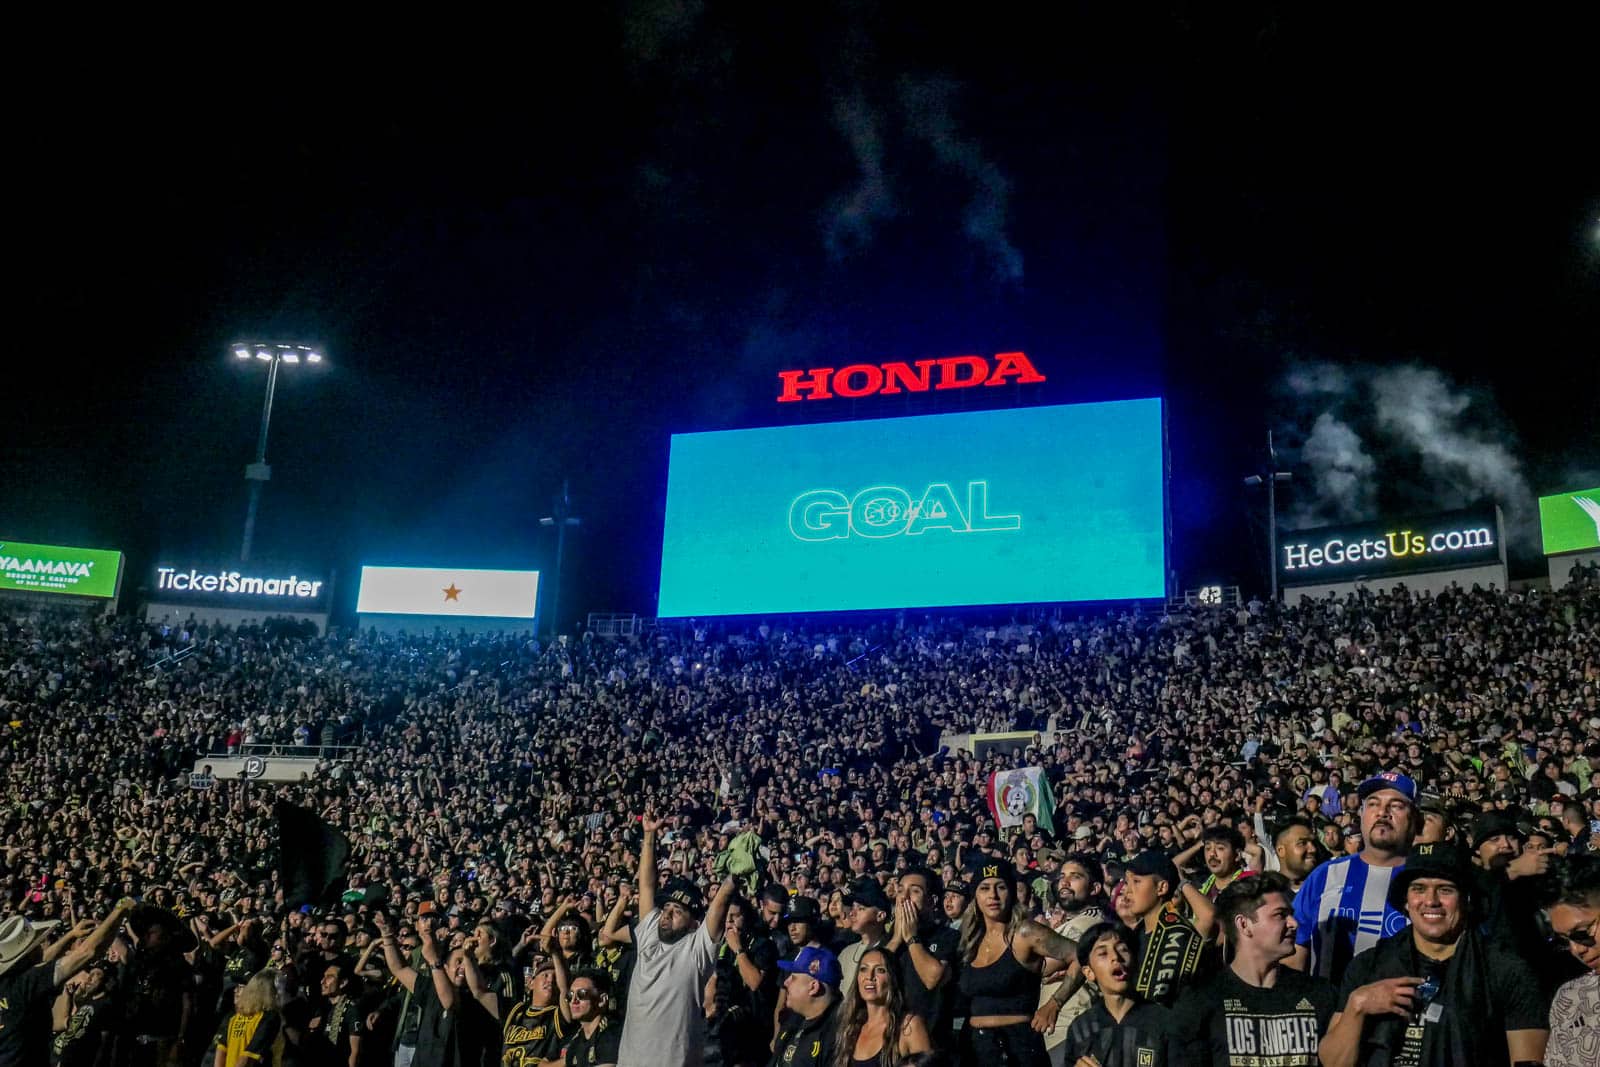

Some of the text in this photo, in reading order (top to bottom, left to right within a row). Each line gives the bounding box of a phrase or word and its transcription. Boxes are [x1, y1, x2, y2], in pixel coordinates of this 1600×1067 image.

[777, 351, 1046, 402] HONDA
[789, 481, 1021, 542] GOAL
[1284, 527, 1493, 570] HeGetsUs.com
[158, 568, 322, 597] TicketSmarter
[247, 760, 260, 773] 12
[1225, 1016, 1318, 1056] LOS ANGELES
